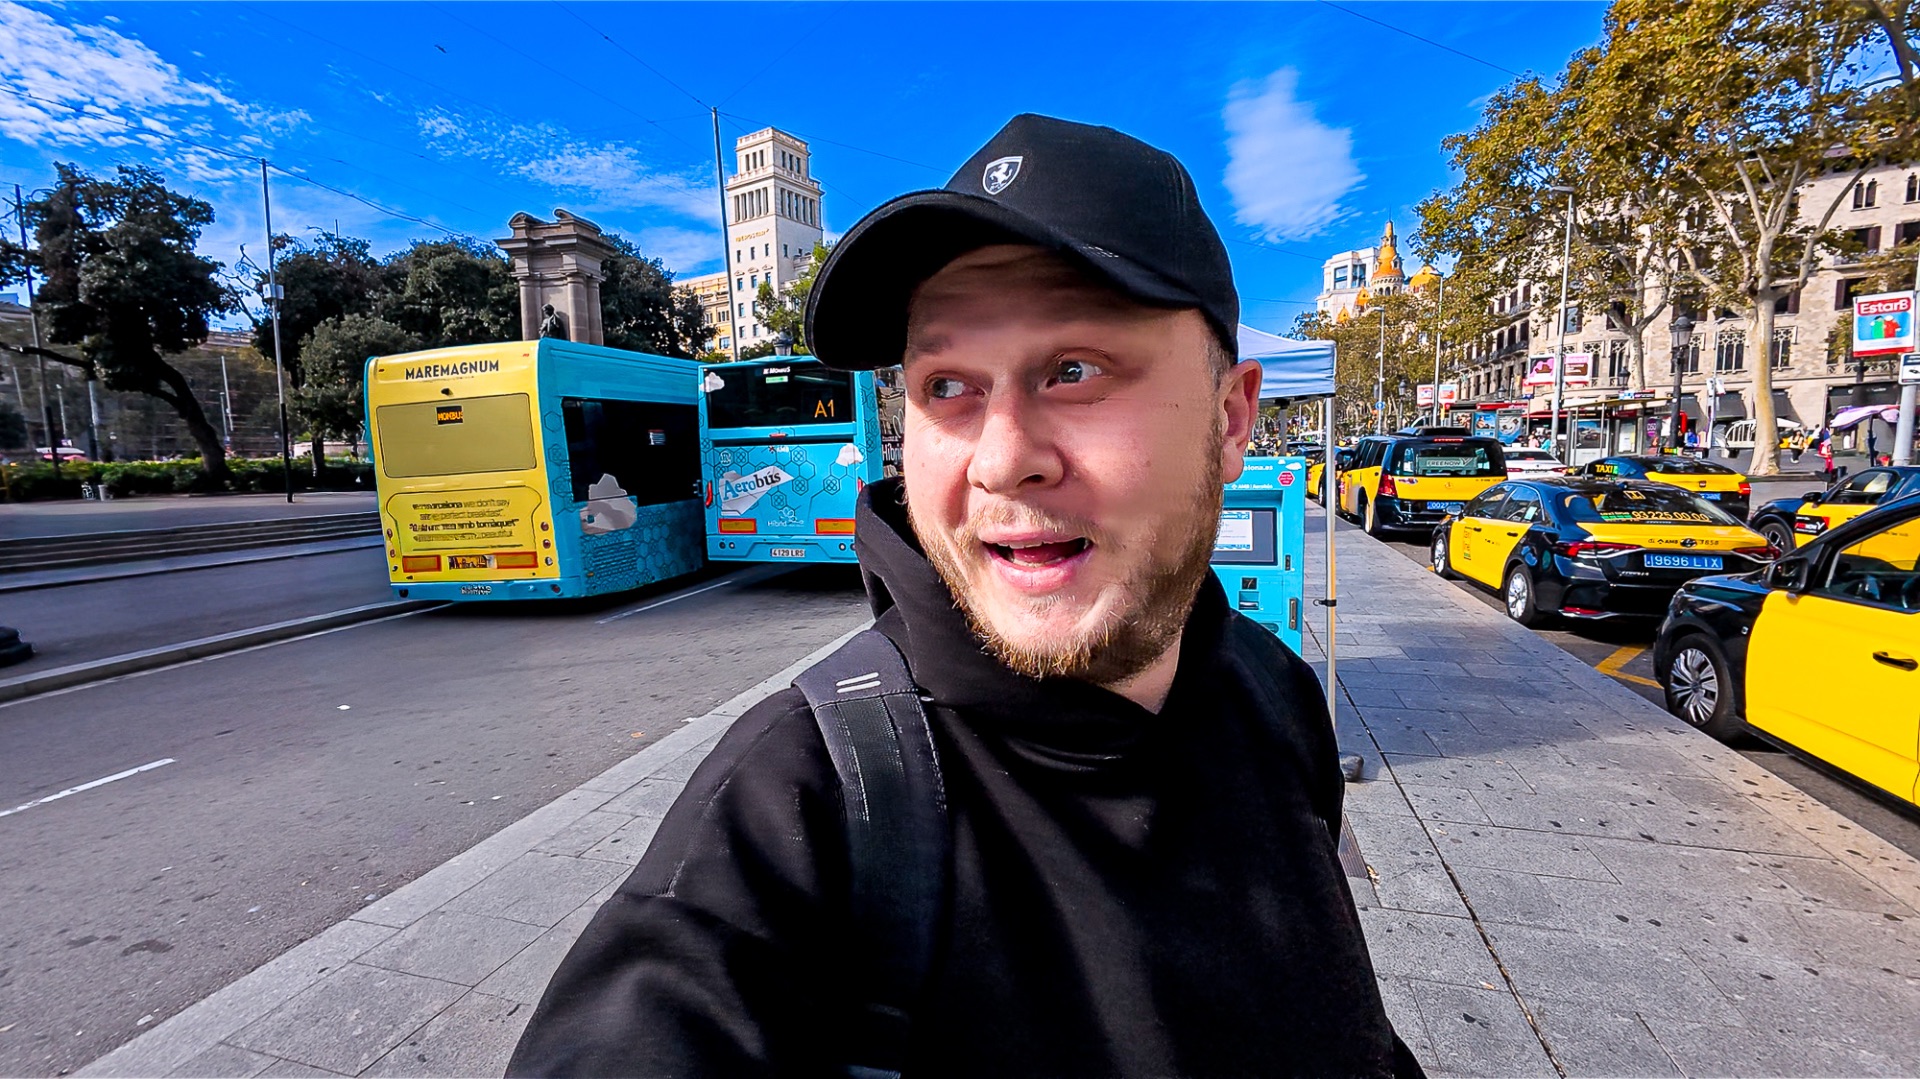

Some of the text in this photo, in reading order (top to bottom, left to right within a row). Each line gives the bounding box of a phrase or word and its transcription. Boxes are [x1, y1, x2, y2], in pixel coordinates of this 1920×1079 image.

[405, 360, 499, 380] MAREMAGNUM
[814, 399, 834, 418] A1
[1595, 464, 1612, 473] TAXI
[723, 471, 781, 501] Aerobús
[1654, 555, 1719, 568] 9696 LIX
